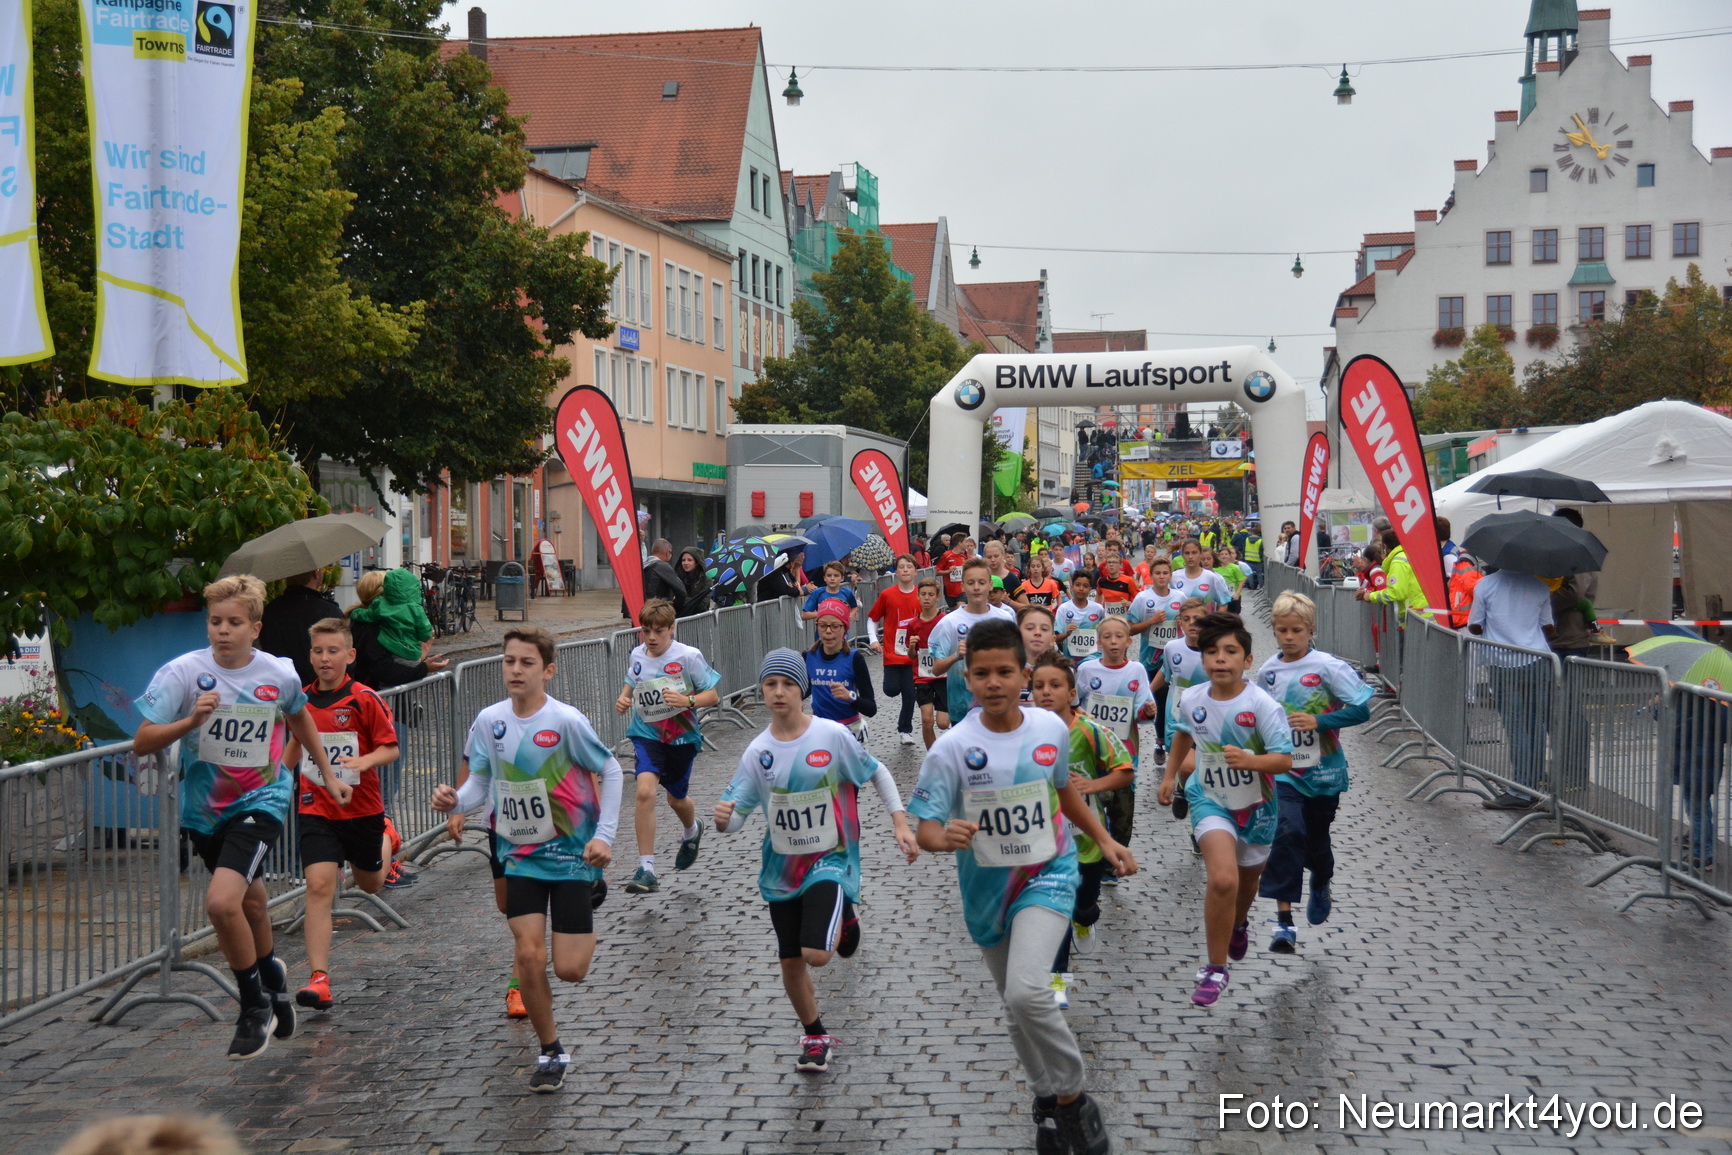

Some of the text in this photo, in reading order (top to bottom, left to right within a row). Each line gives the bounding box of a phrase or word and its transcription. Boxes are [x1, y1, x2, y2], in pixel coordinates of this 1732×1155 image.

[96, 7, 190, 32] Fairtrade
[135, 37, 185, 55] Towns
[196, 43, 233, 56] FAIRTRADE
[104, 141, 206, 175] Wir sind
[106, 222, 185, 250] Stadt
[996, 360, 1233, 391] BMW Laufsport
[1350, 380, 1426, 534] REWE
[1168, 465, 1197, 476] ZIEL
[566, 407, 634, 557] REWE
[1303, 443, 1326, 521] REWE
[858, 460, 904, 535] REWE
[1029, 594, 1046, 604] sky
[1106, 606, 1125, 615] 4028
[1071, 635, 1095, 647] 4036
[921, 656, 933, 667] 40
[639, 687, 670, 707] 402
[236, 705, 271, 715] BOCK
[644, 706, 675, 716] Maximilian
[1091, 703, 1128, 723] 4032
[208, 718, 268, 743] 4024
[537, 734, 558, 743] Hervis
[1291, 729, 1315, 748] 03
[224, 747, 248, 759] Felix
[810, 754, 830, 763] Hervis
[967, 773, 993, 782] PARTL
[1204, 766, 1254, 788] 4109
[793, 790, 826, 801] BOCK
[1002, 783, 1042, 800] BOCK
[502, 796, 546, 821] 4016
[775, 803, 828, 831] 4017
[978, 801, 1045, 837] 4034
[509, 826, 539, 837] Jannick
[787, 834, 821, 846] Tamina
[1000, 843, 1031, 855] Islam
